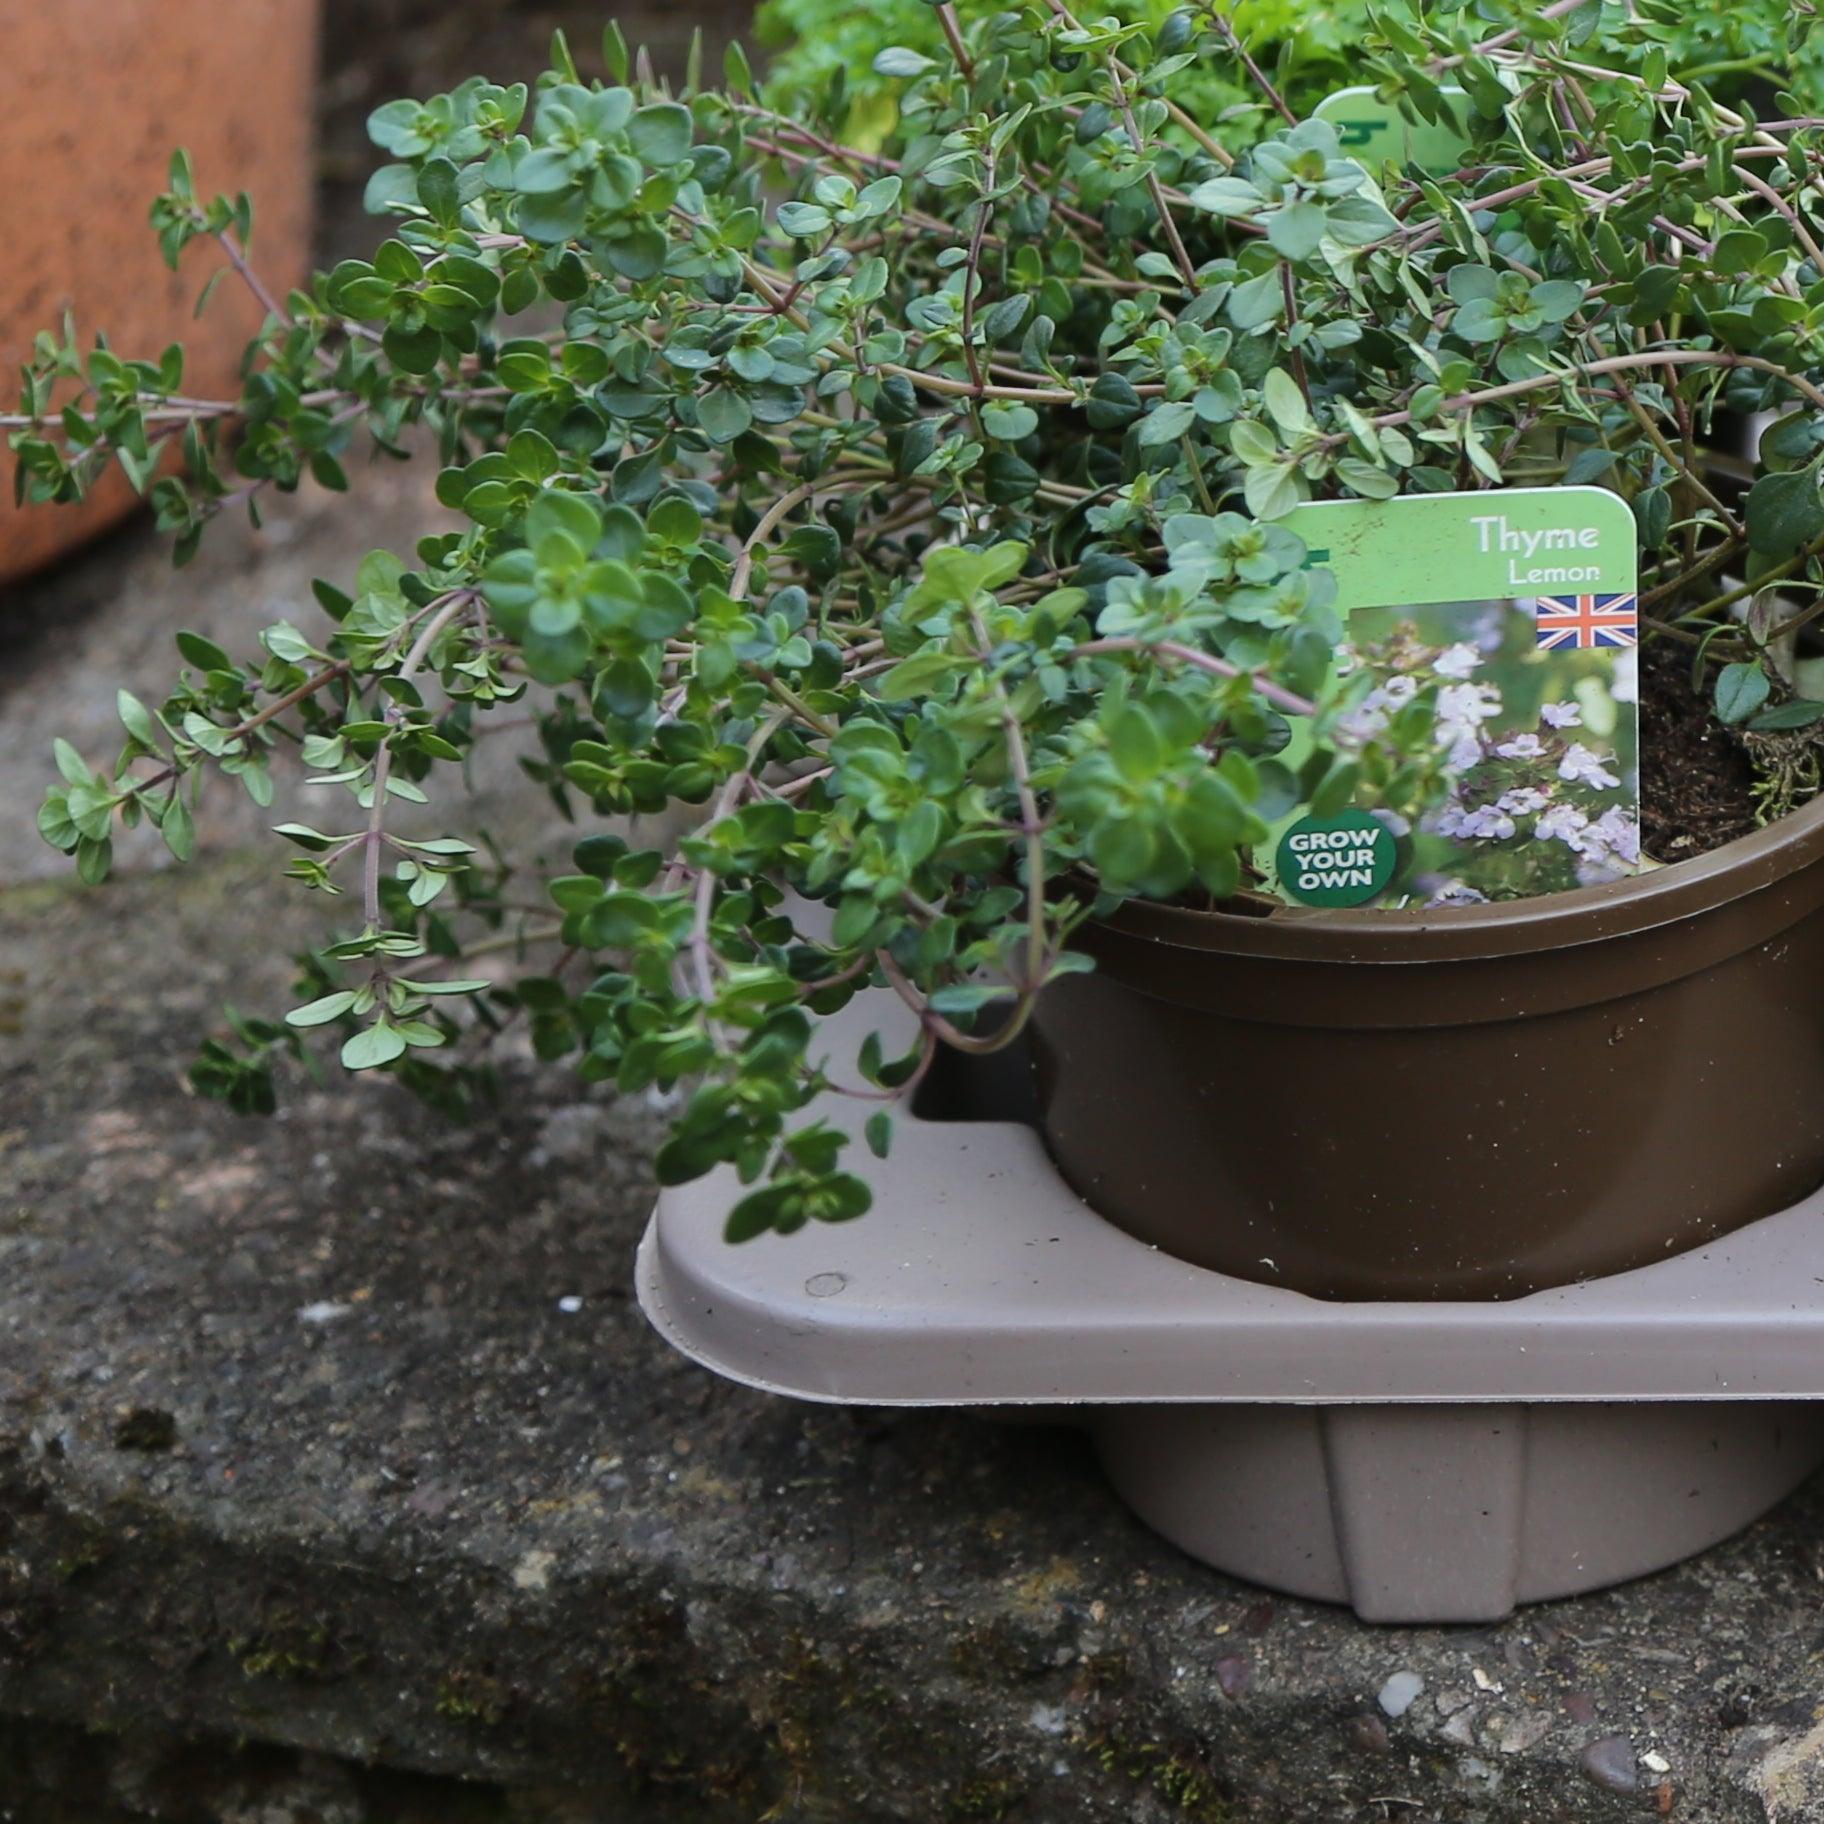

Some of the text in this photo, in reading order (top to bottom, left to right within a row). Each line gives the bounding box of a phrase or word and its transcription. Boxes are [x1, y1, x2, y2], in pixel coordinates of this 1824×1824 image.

[1470, 515, 1600, 559] Thyme
[1508, 559, 1600, 585] Lemon
[1288, 827, 1381, 852] GROW
[1294, 848, 1377, 872] YOUR
[1297, 868, 1374, 892] OWN
